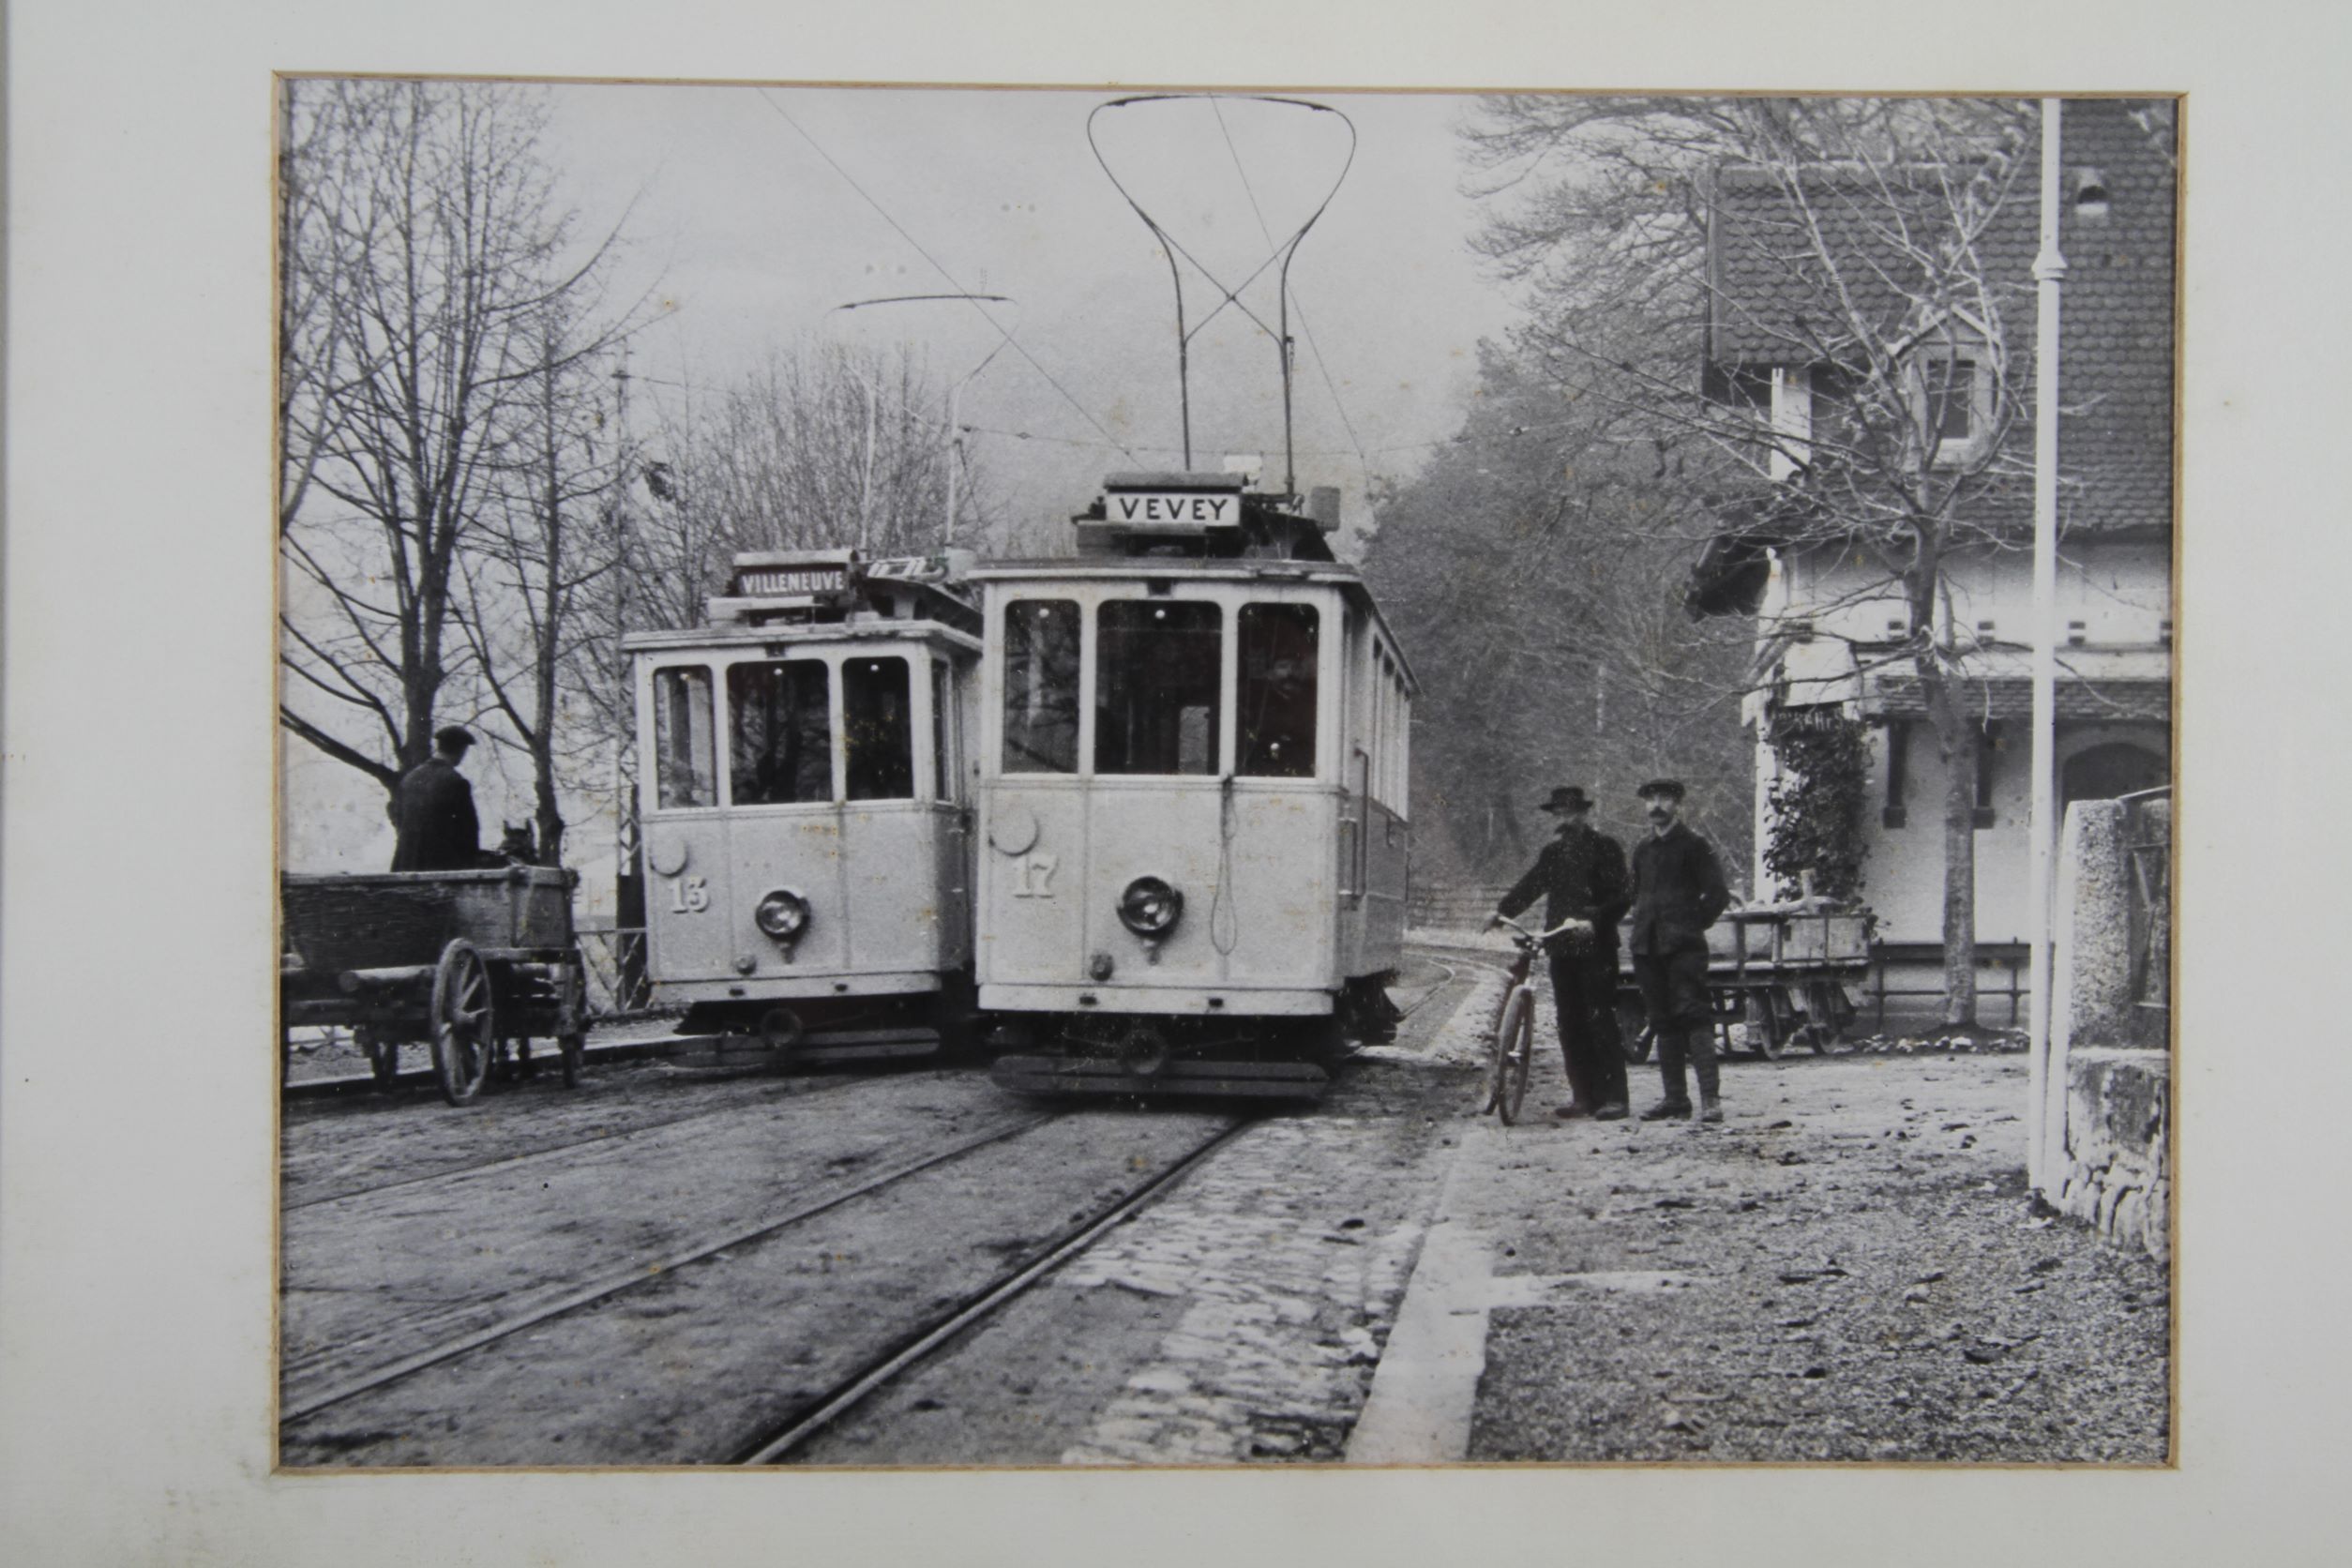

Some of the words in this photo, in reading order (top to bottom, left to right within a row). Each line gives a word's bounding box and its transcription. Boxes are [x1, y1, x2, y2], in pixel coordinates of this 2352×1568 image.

[1119, 497, 1229, 521] VEVEY
[741, 570, 844, 595] VILLENEUVE
[1011, 854, 1060, 899] 17
